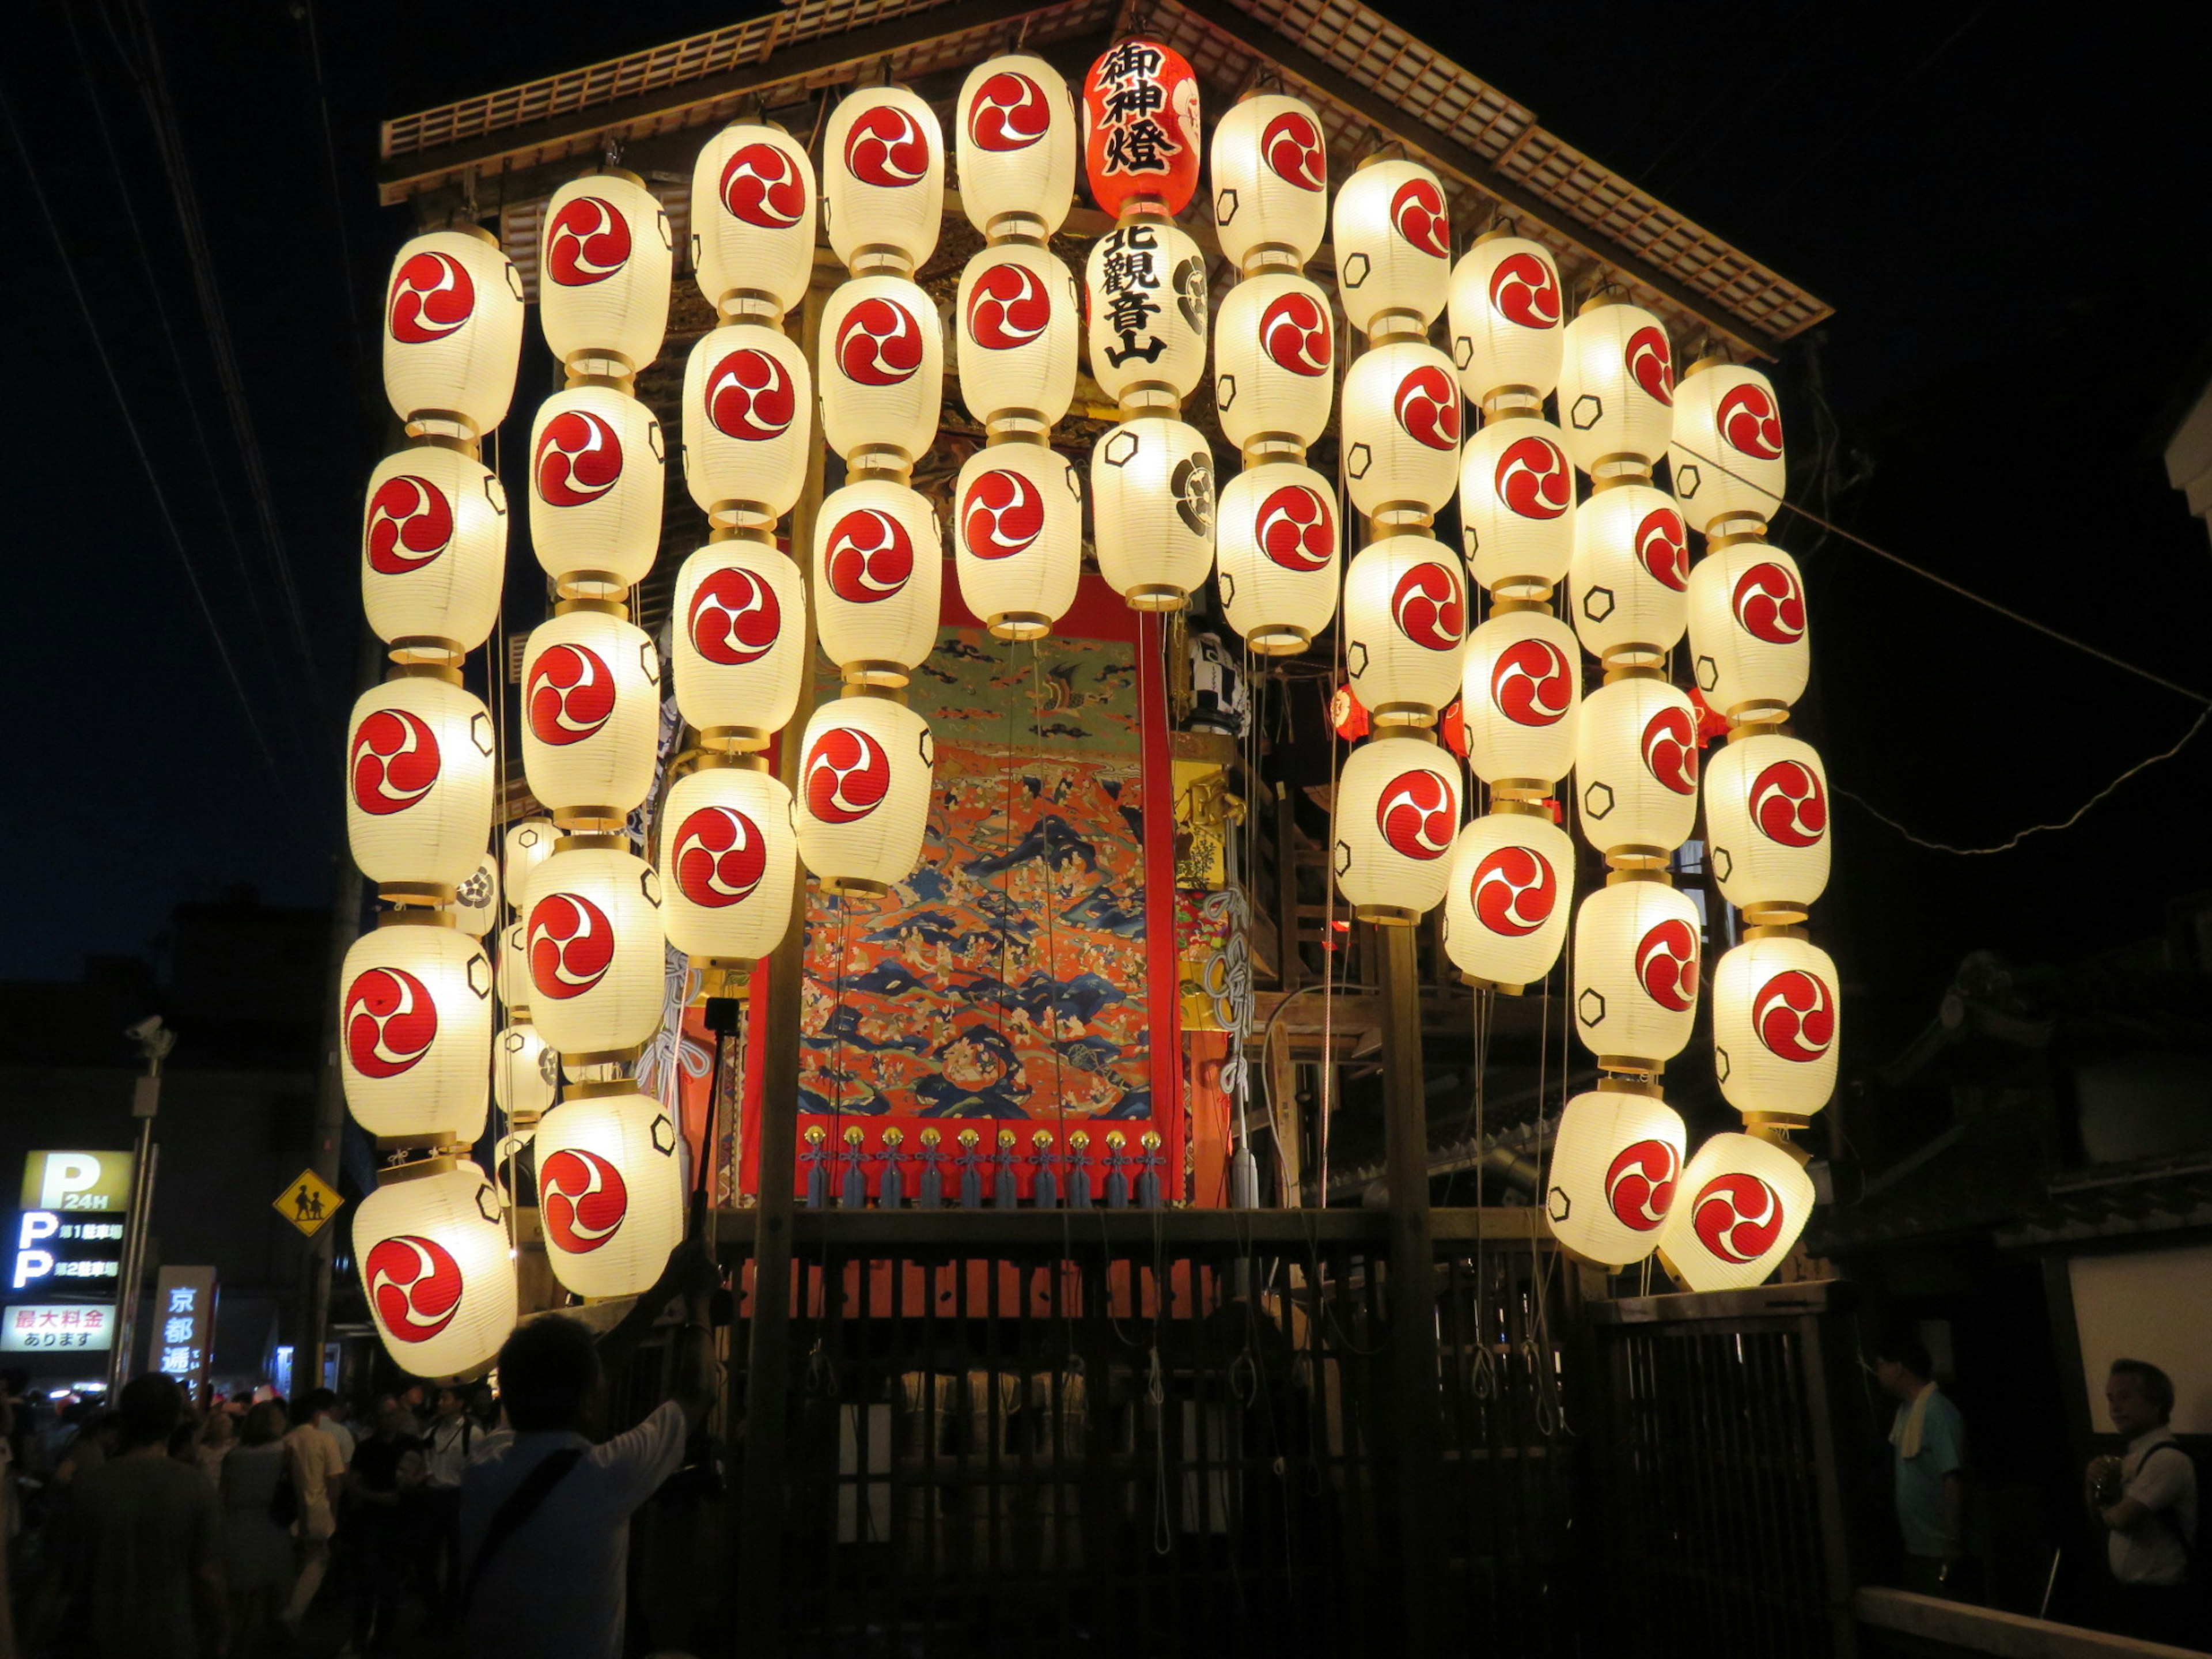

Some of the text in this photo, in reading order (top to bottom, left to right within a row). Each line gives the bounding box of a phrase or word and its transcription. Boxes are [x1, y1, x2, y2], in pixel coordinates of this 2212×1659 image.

[1094, 43, 1181, 175] 御神燈
[1099, 225, 1168, 369] 北觀音山
[40, 1153, 100, 1209] P
[64, 1194, 109, 1209] 24H
[19, 1212, 59, 1249] P
[13, 1250, 54, 1288] P
[16, 1310, 104, 1328] 最大料金
[160, 1287, 197, 1383] 京都逓
[24, 1332, 91, 1347] あります
